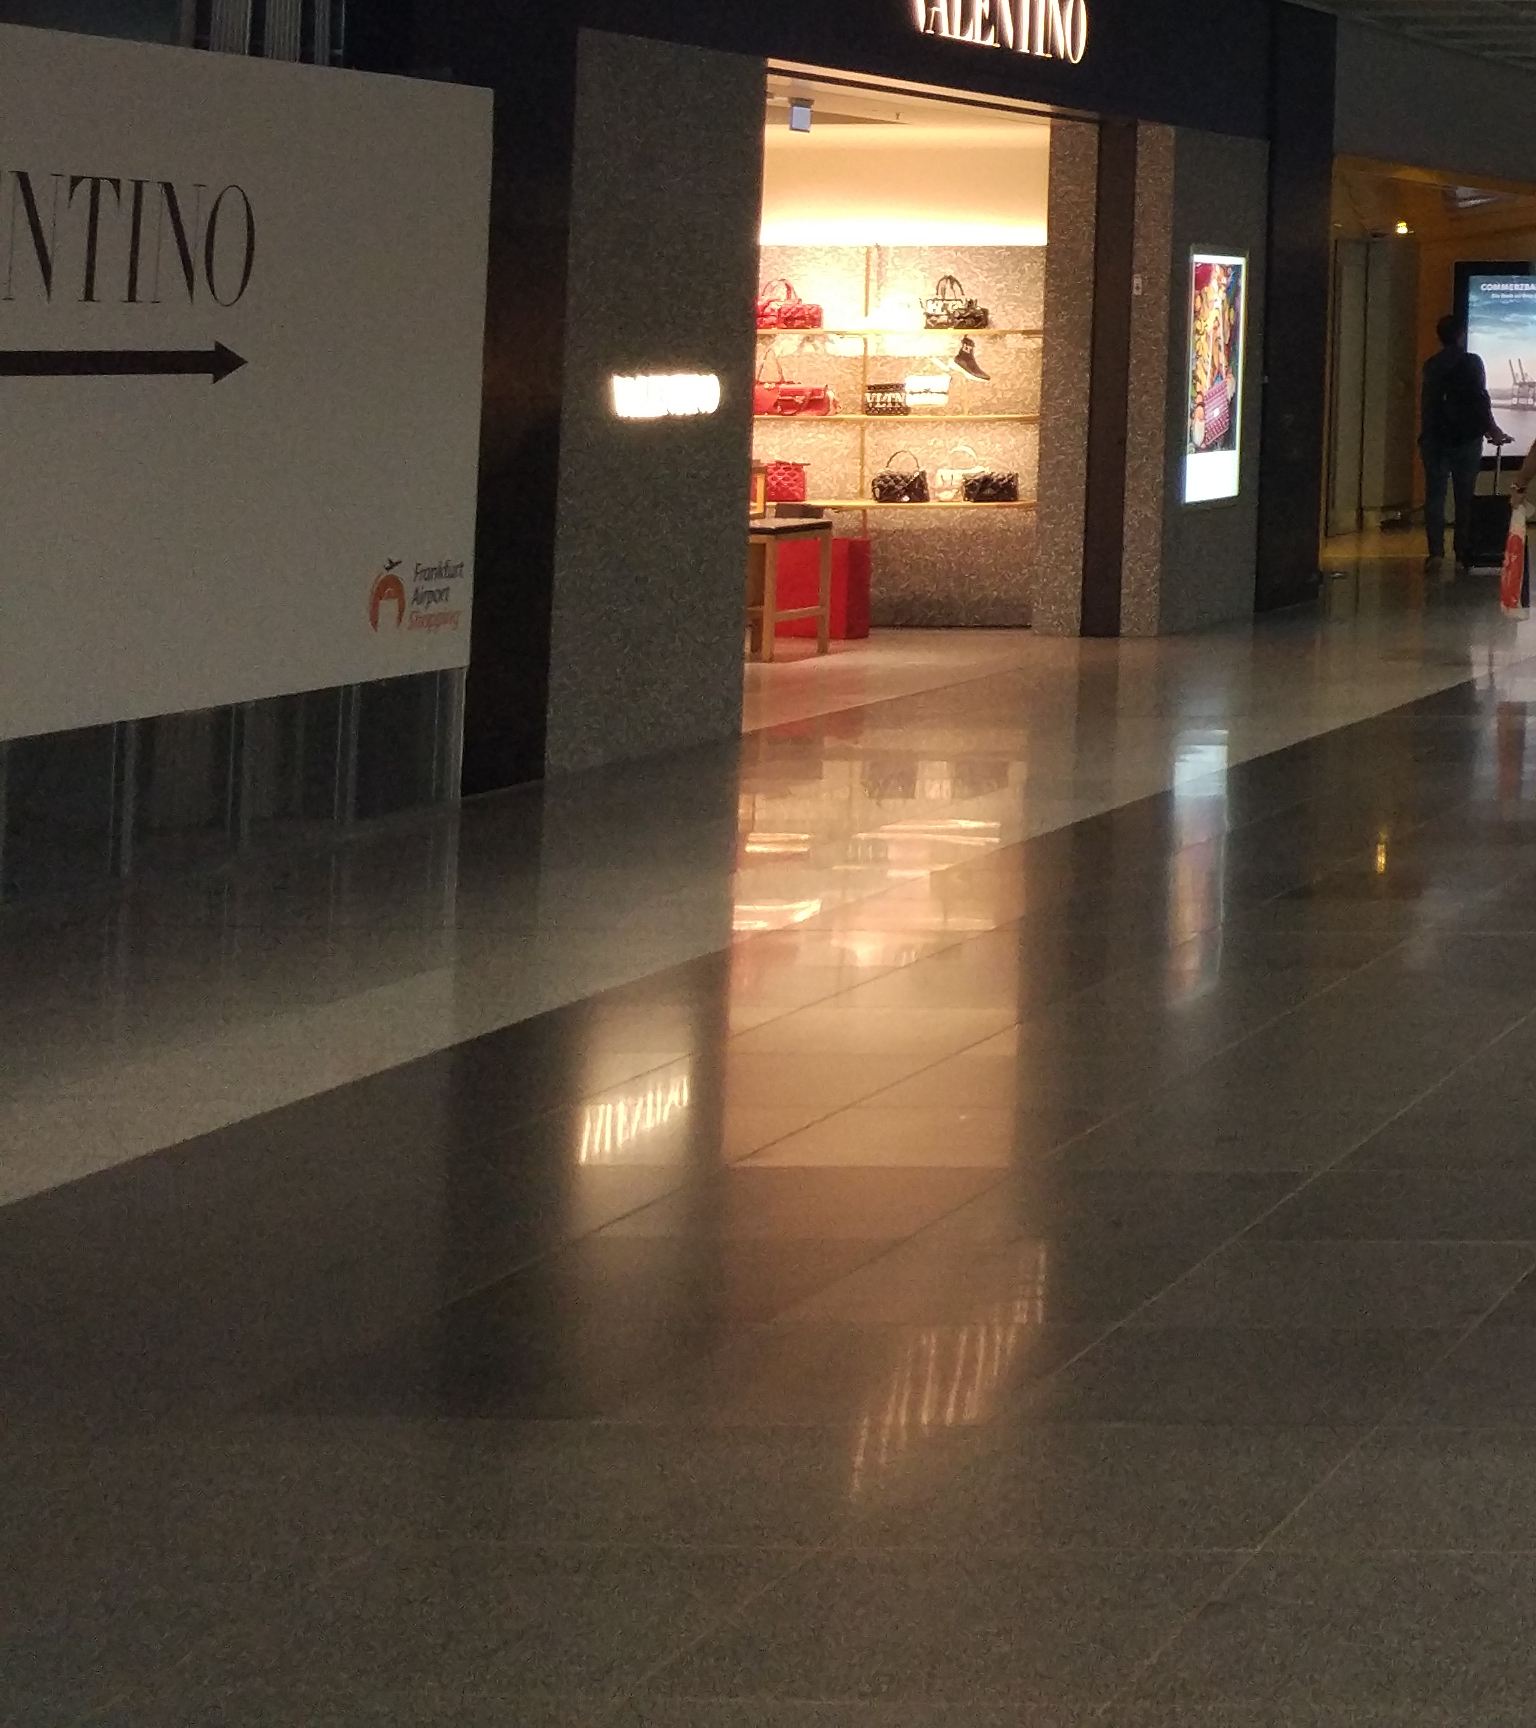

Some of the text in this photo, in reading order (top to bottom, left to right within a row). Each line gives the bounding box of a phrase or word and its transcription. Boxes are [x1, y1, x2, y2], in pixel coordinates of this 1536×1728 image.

[0, 170, 256, 307] NTINO
[413, 559, 465, 582] Frankfurt
[410, 586, 450, 610] Airport
